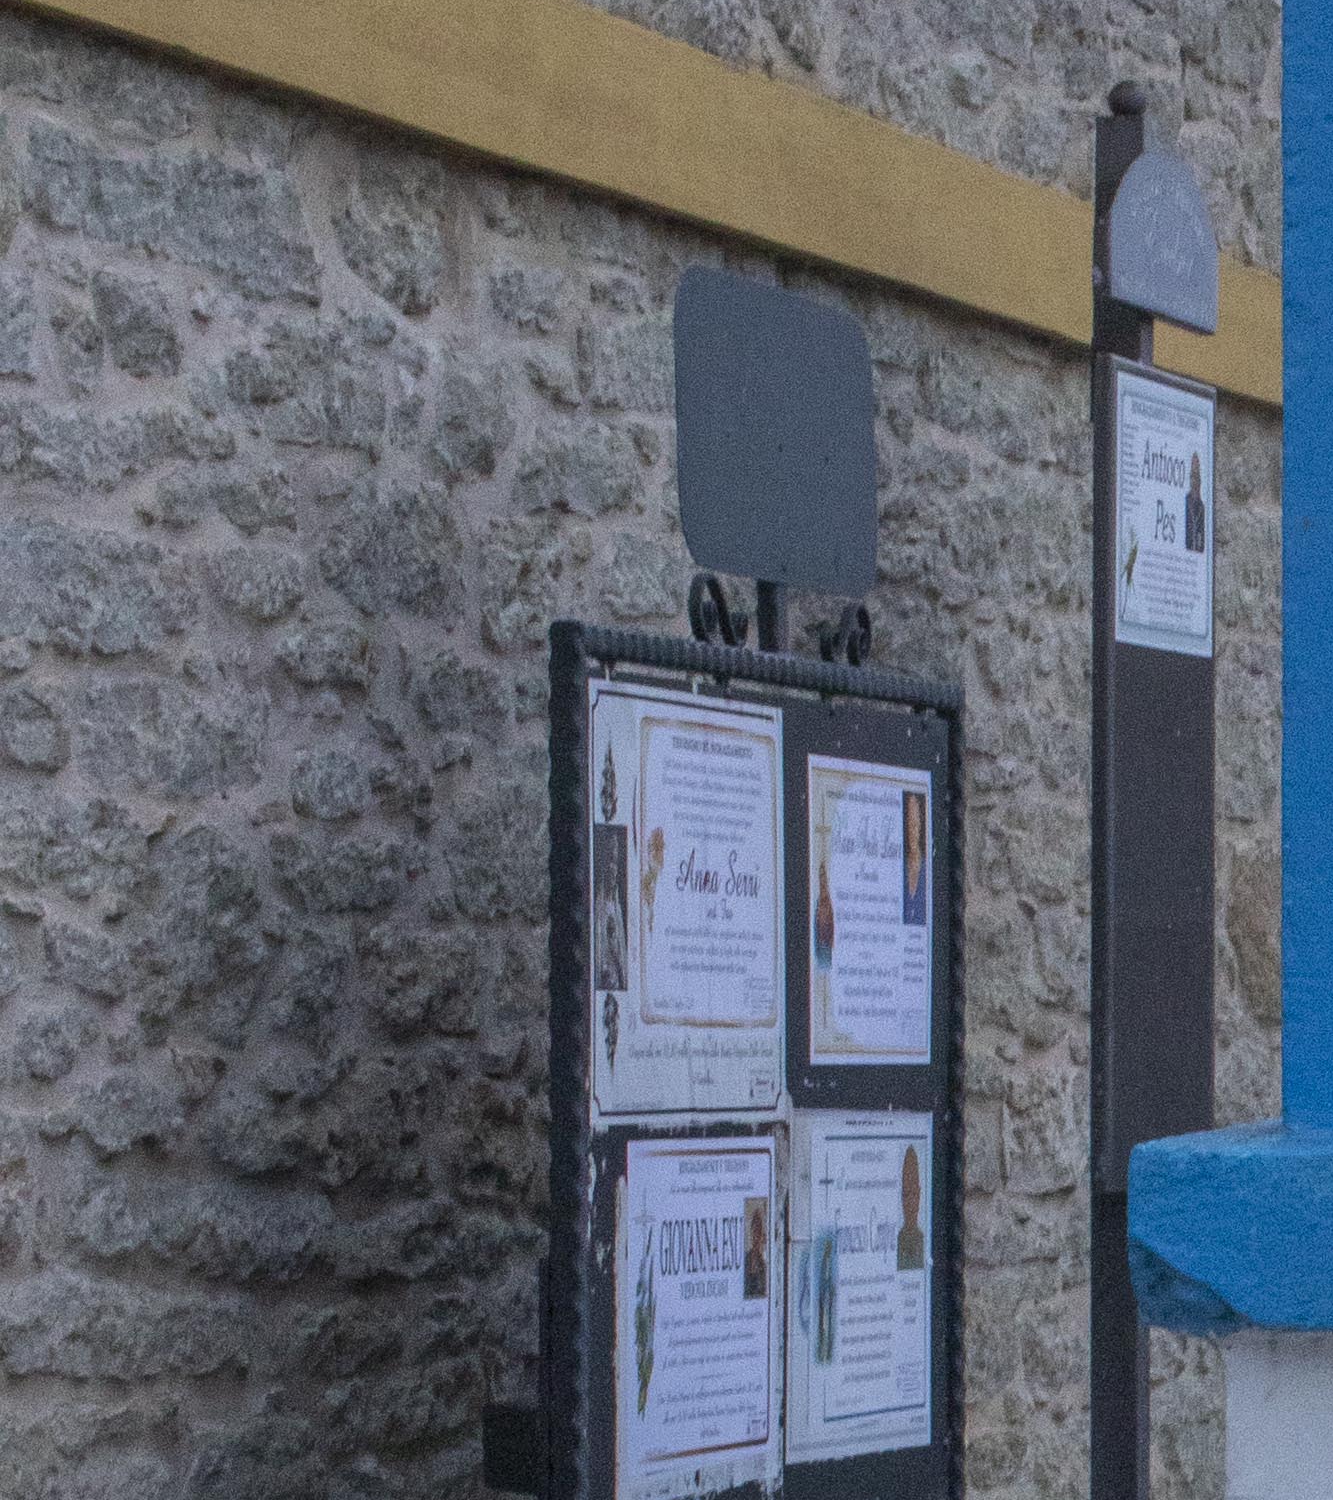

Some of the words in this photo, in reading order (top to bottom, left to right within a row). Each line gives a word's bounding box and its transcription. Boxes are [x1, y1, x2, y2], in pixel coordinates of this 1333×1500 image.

[1140, 438, 1186, 489] Antioco
[1153, 498, 1177, 544] Pes
[677, 848, 719, 894] Anna
[659, 1217, 720, 1276] GIOVANNA
